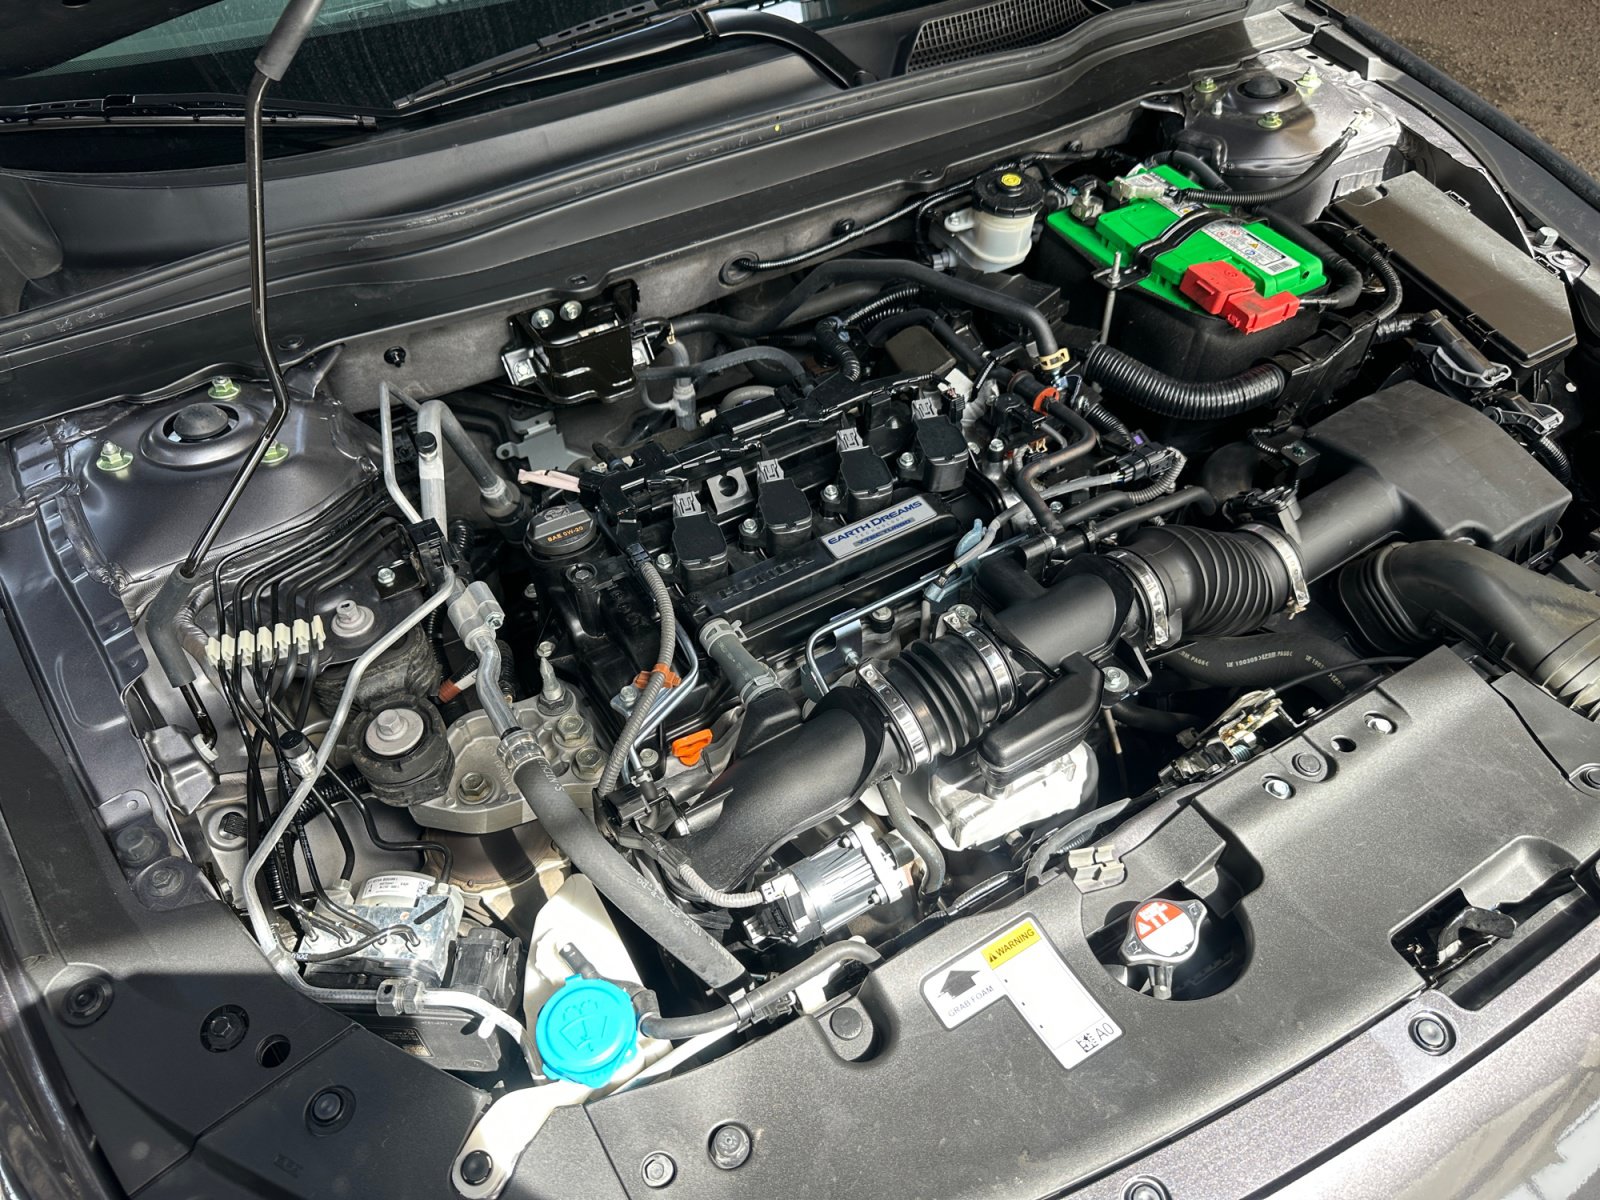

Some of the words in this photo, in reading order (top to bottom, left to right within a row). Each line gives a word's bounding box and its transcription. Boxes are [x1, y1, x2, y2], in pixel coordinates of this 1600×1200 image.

[828, 523, 871, 545] EARTH
[870, 501, 922, 526] DREAMS
[717, 557, 815, 601] HONDA
[995, 928, 1035, 957] WARNING
[948, 1000, 971, 1018] GRAB
[971, 985, 994, 1003] FOAM
